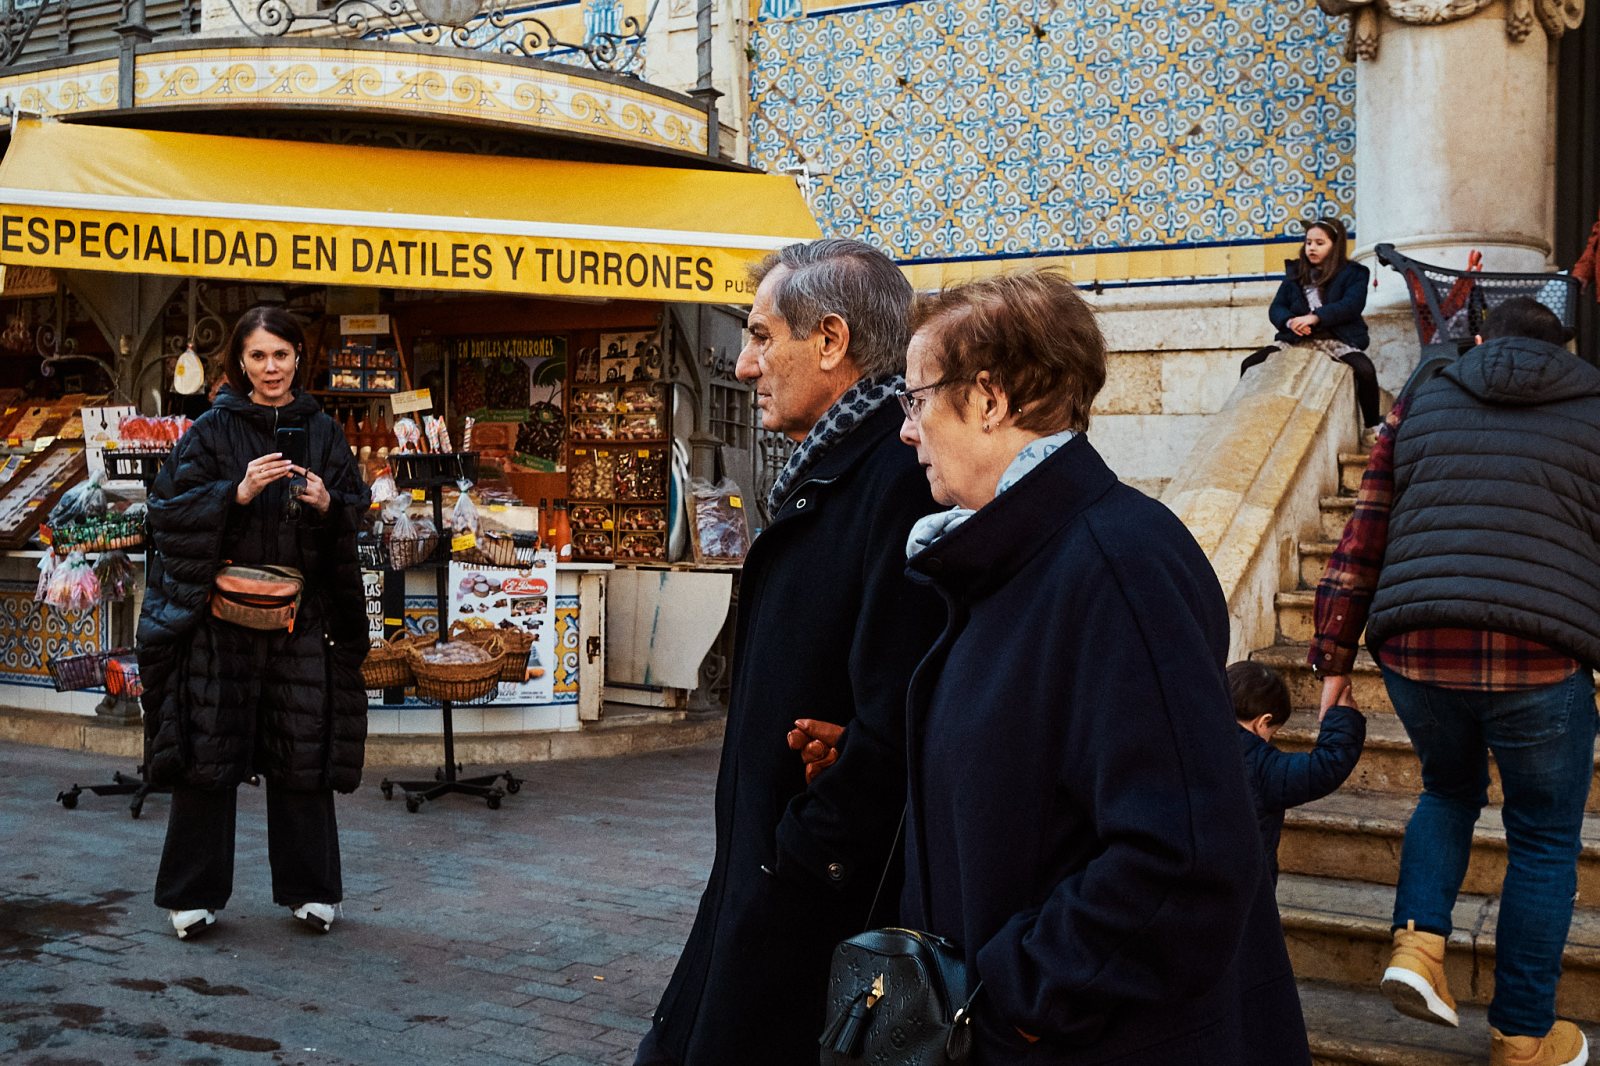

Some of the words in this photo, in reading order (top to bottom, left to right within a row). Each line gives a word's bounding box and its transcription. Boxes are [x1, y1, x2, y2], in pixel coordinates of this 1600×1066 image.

[2, 215, 278, 267] ESPECIALIDAD
[293, 234, 337, 271] EN
[353, 239, 493, 280] DATILES
[505, 246, 525, 280] Y
[536, 248, 714, 291] TURRONES
[458, 339, 469, 358] EN
[512, 337, 553, 357] TURRONES
